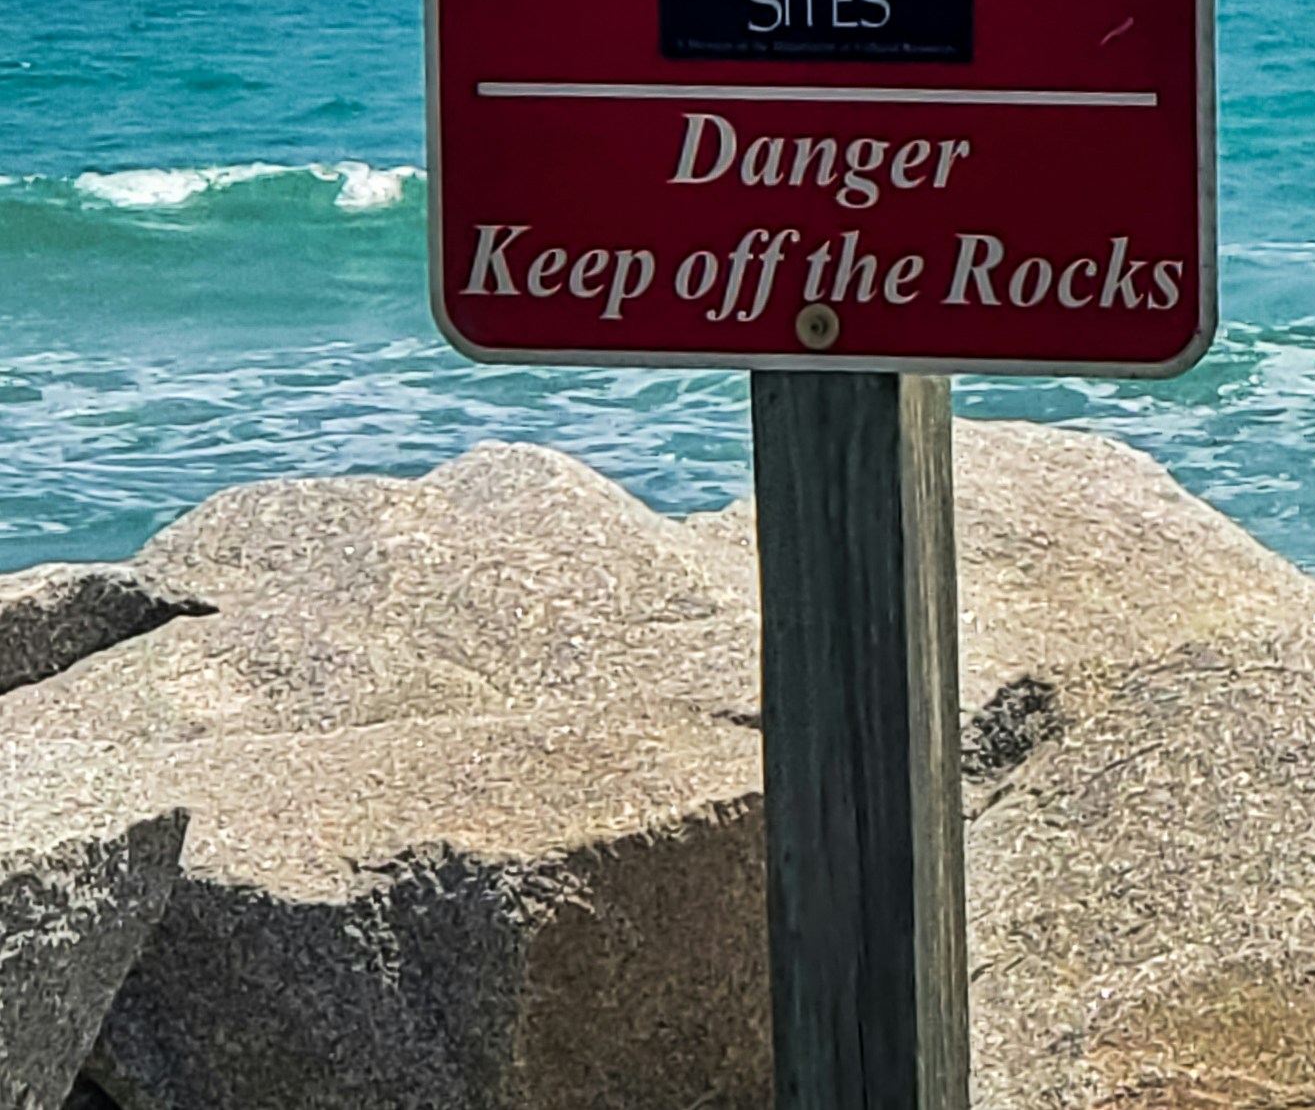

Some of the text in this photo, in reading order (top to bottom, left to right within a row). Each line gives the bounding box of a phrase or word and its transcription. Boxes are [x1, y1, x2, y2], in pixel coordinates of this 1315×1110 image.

[668, 112, 971, 209] Danger
[459, 224, 1184, 322] Keep off the Rocks
